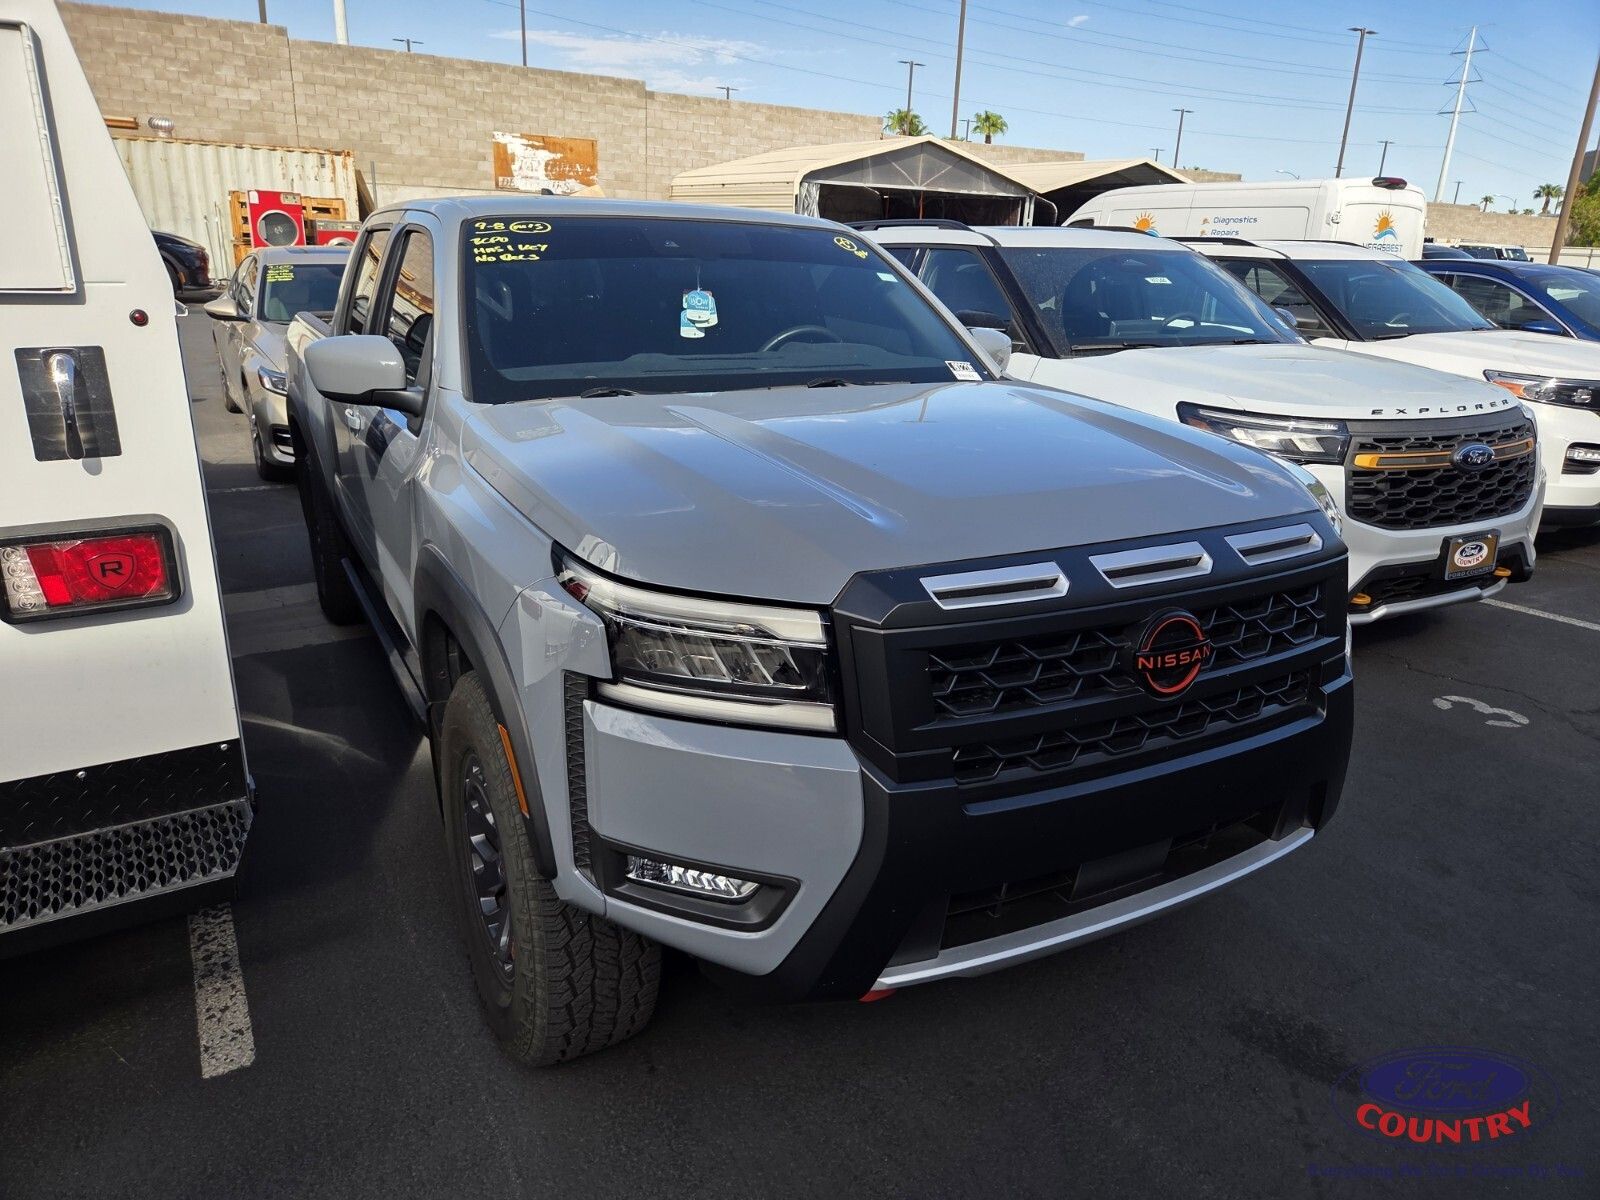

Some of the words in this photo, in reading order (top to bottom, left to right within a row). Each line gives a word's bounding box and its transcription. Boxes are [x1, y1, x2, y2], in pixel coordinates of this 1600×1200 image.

[1213, 216, 1258, 226] Diagnostics
[1210, 229, 1240, 237] Repairs
[1371, 399, 1509, 416] EXPLORER
[1467, 449, 1489, 464] Ford
[1462, 544, 1481, 556] Ford
[1457, 555, 1484, 566] COUNTRY
[100, 560, 124, 577] R
[1138, 645, 1211, 669] NISSAN
